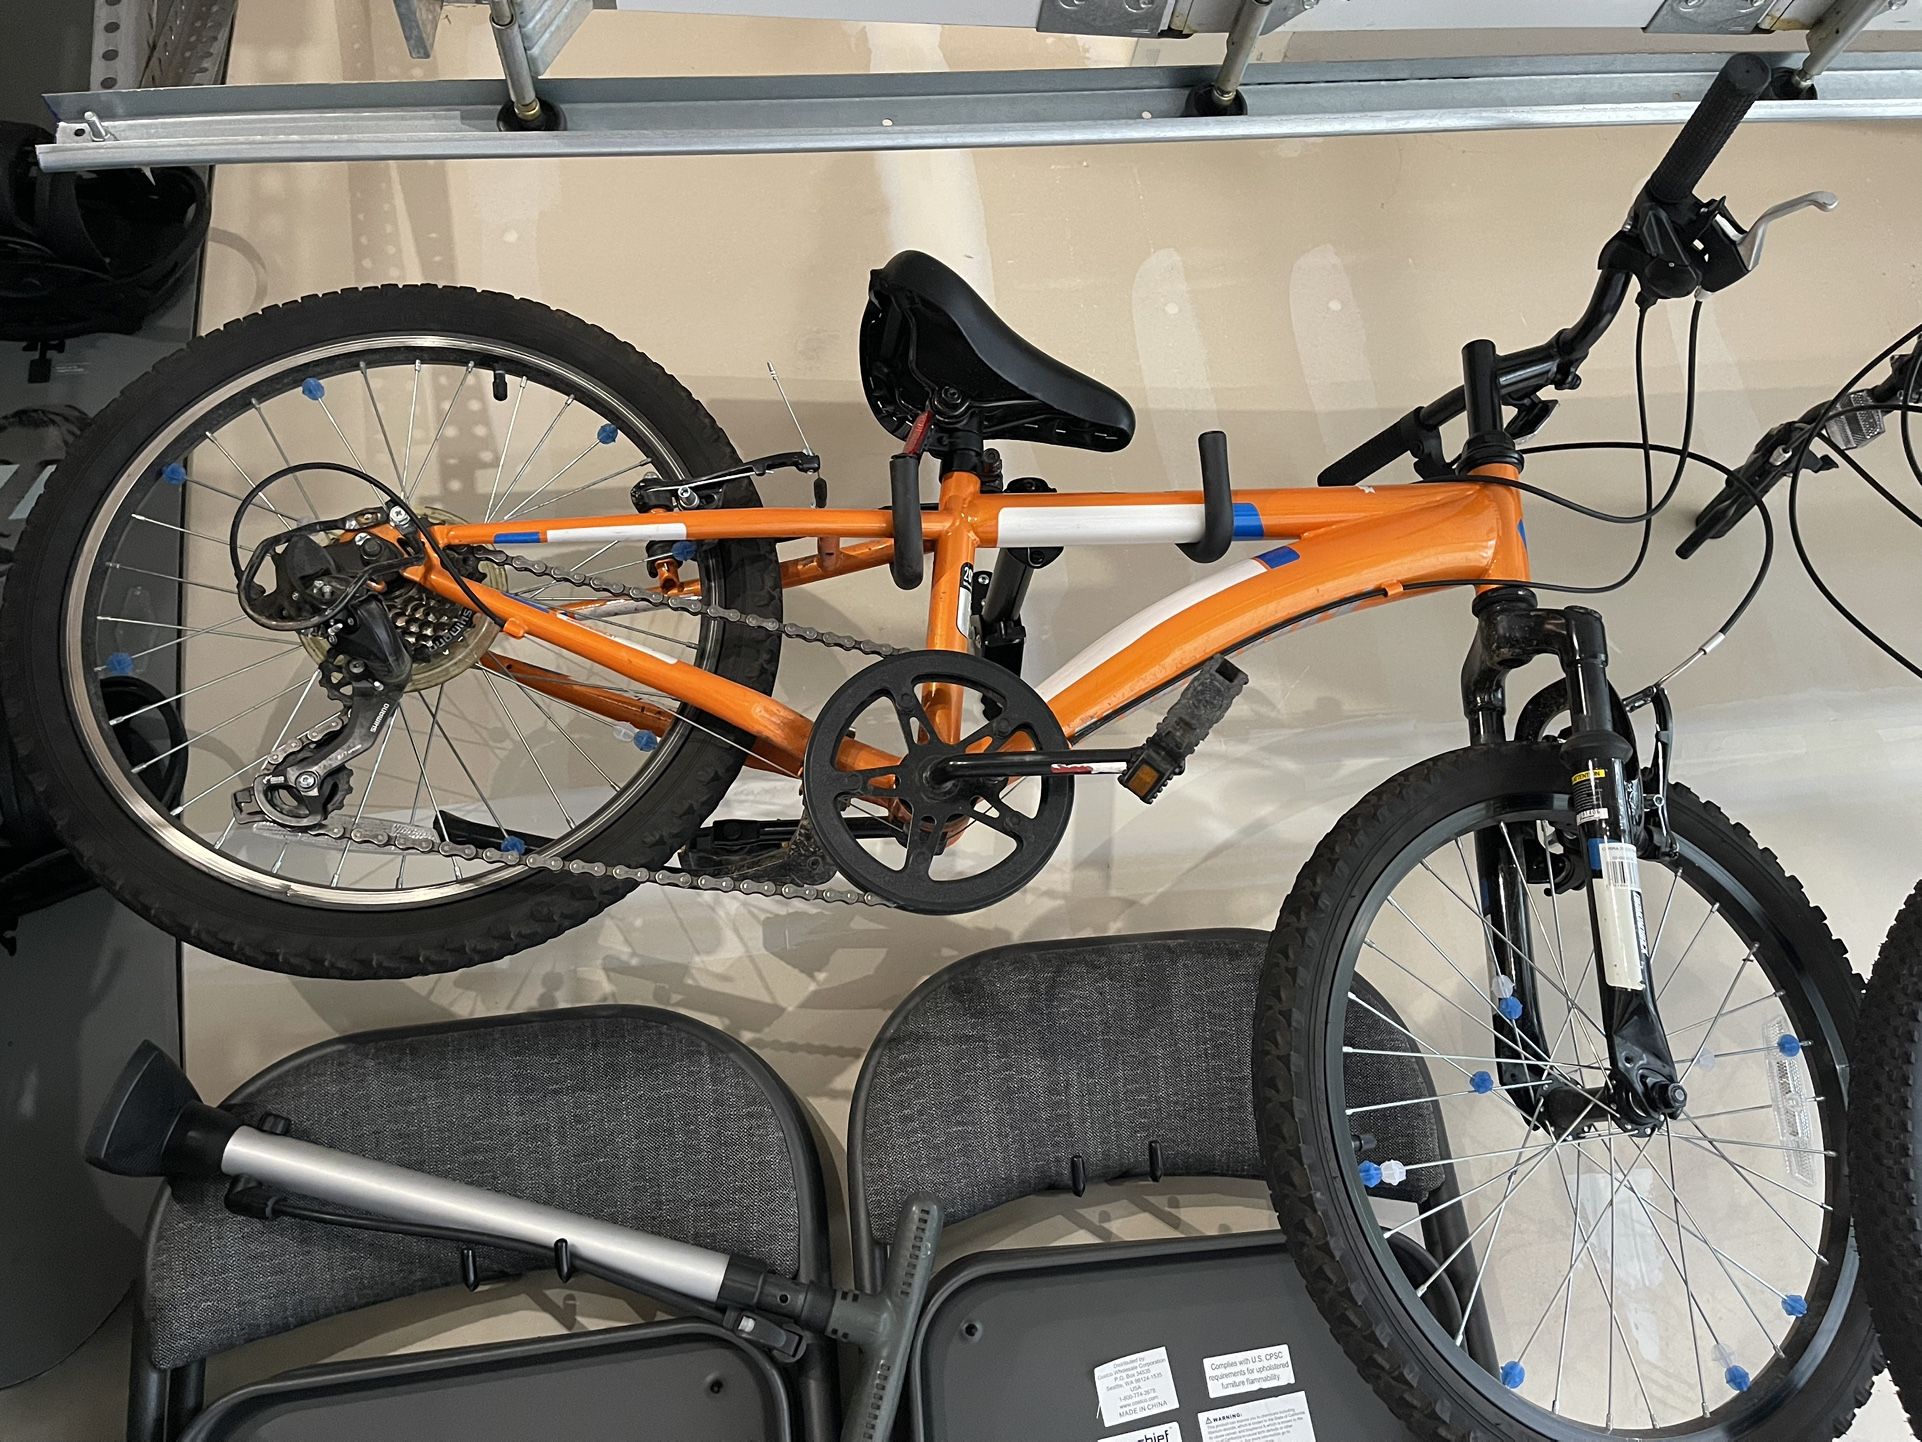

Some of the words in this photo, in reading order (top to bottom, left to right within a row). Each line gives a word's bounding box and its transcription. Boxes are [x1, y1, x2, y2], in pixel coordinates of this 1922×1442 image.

[429, 608, 473, 652] SHIMANO
[370, 702, 390, 733] SHIMANO
[1573, 770, 1601, 782] ATTENTON
[1138, 1358, 1166, 1370] Corporation
[1210, 1361, 1238, 1371] Complies
[1238, 1357, 1250, 1366] with
[1251, 1355, 1264, 1364] U.S.
[1265, 1351, 1284, 1361] CPSC
[1208, 1369, 1246, 1382] requirements
[1246, 1366, 1255, 1375] for
[1256, 1361, 1290, 1374] upholstered
[1221, 1378, 1245, 1390] furniture
[1119, 1407, 1138, 1418] MADE
[1146, 1400, 1168, 1411] CHINA
[1213, 1412, 1242, 1422] WARNING:
[1138, 1429, 1169, 1442] hief
